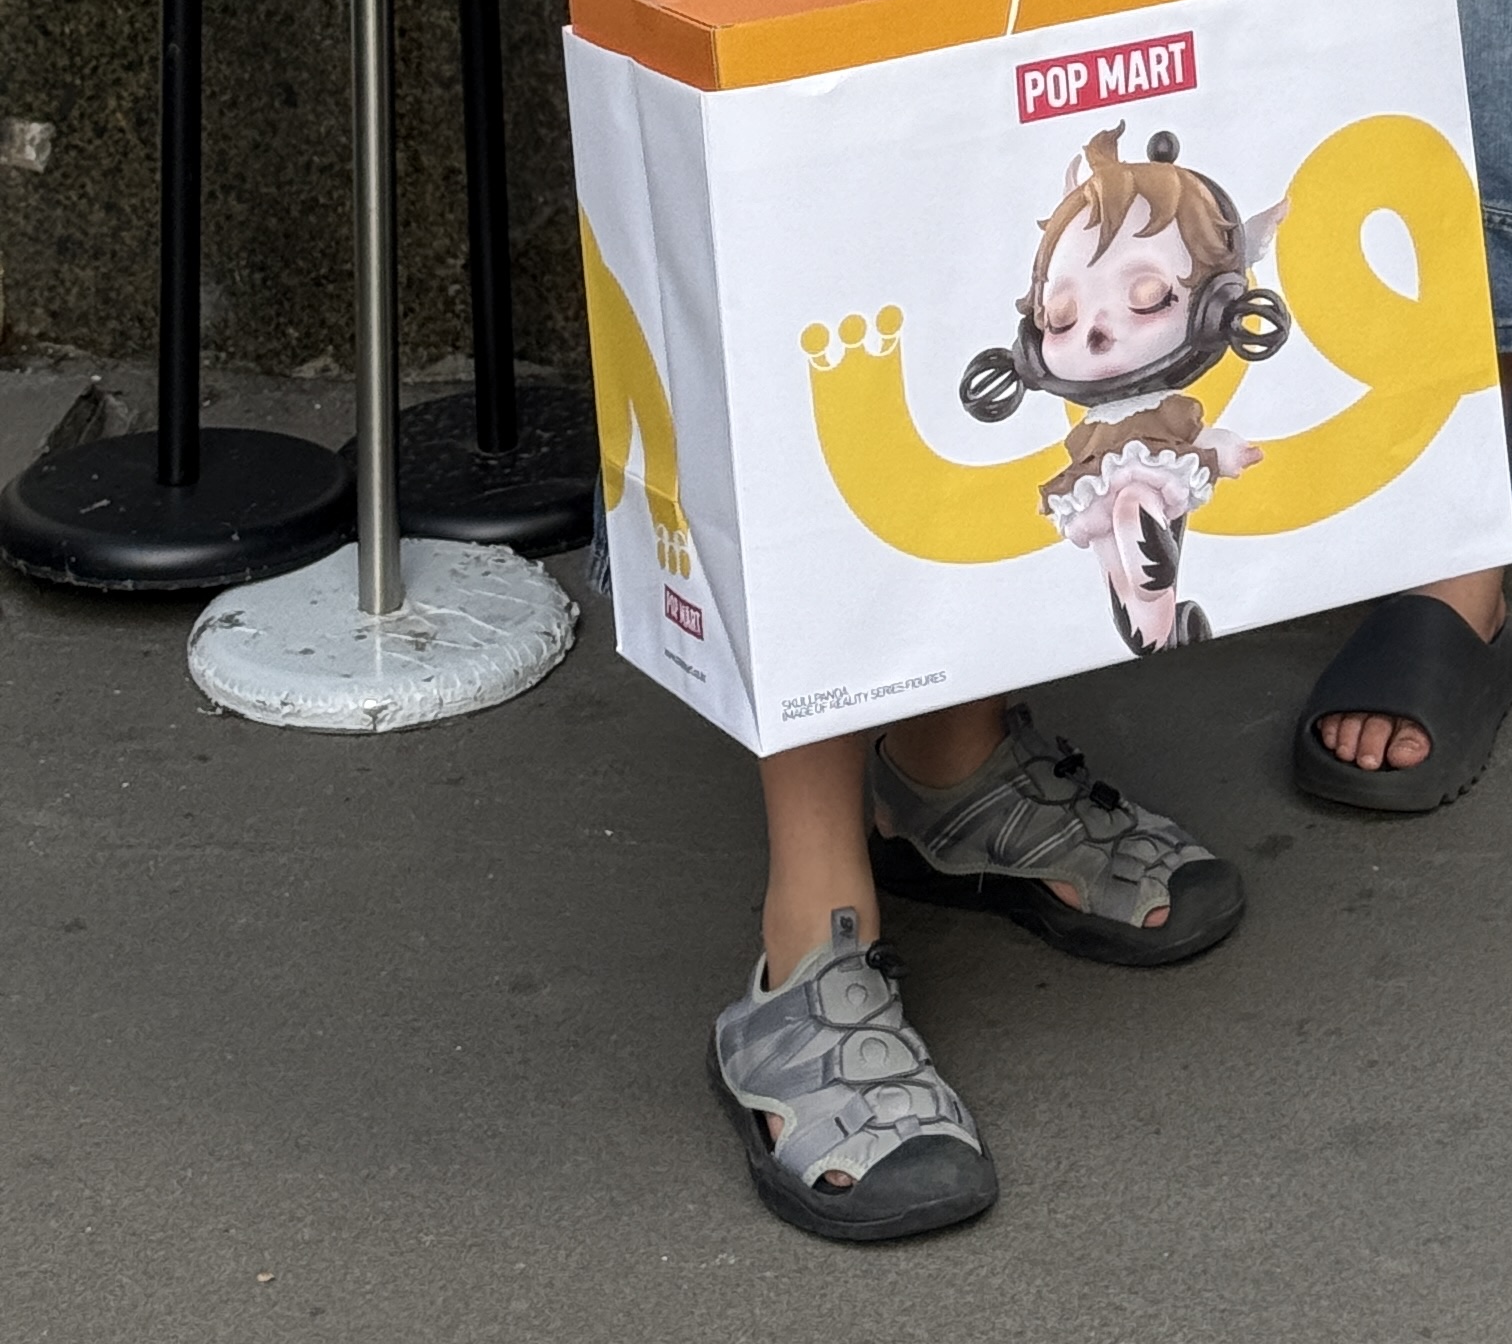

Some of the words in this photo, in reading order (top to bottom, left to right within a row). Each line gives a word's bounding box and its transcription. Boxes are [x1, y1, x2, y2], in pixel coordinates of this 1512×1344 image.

[1023, 61, 1088, 114] POP
[1096, 40, 1187, 100] MART
[871, 681, 905, 700] SERIES
